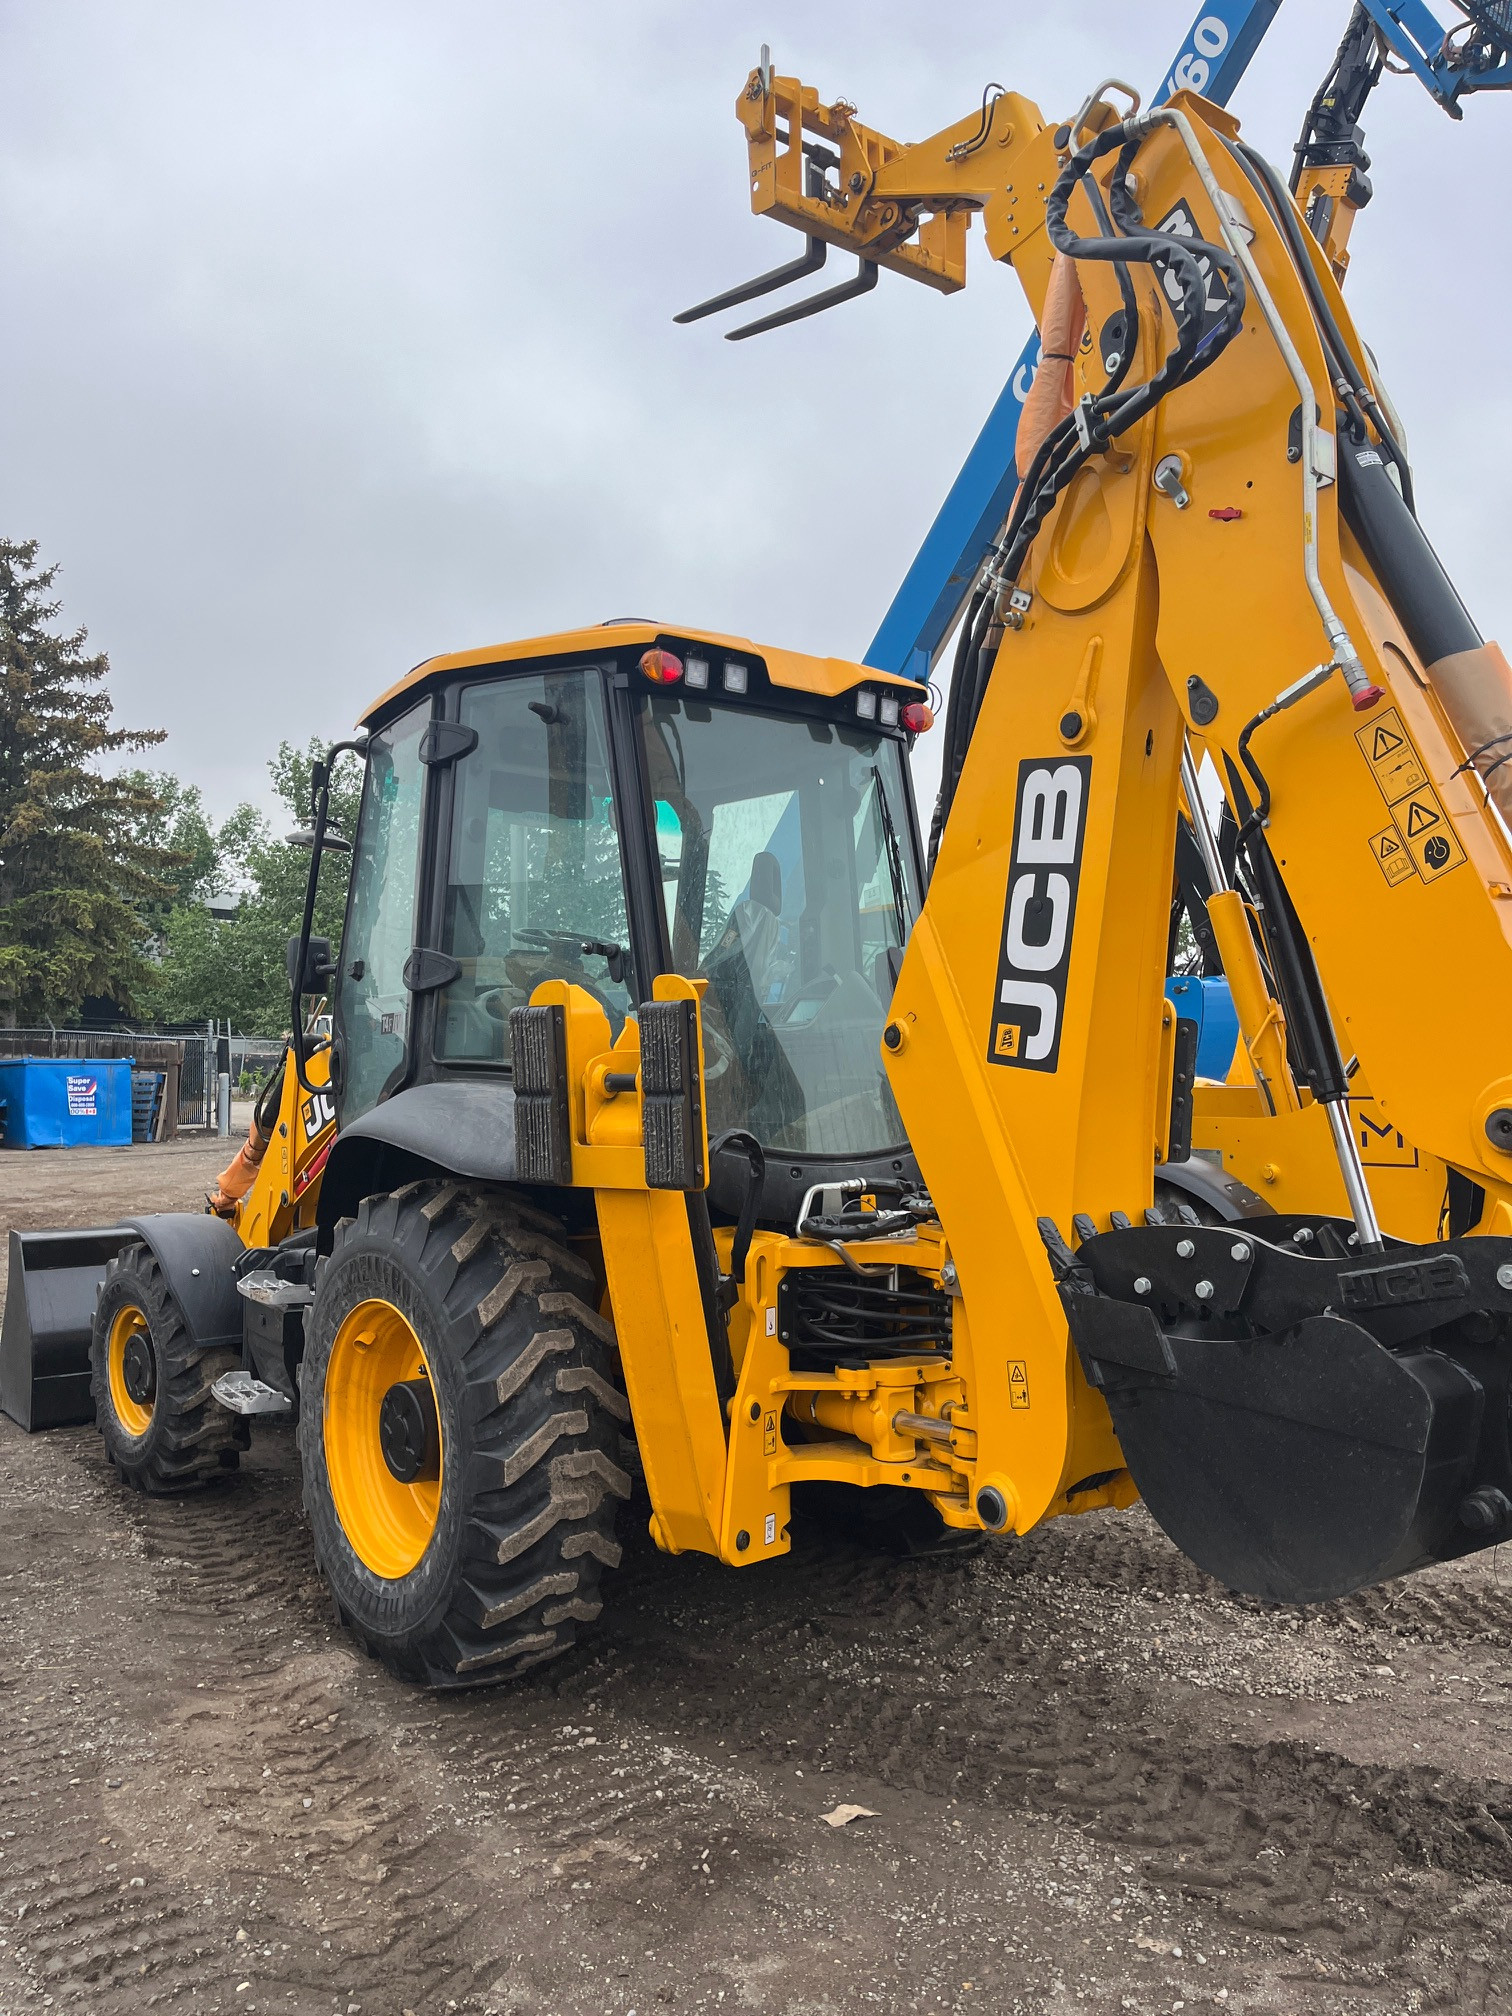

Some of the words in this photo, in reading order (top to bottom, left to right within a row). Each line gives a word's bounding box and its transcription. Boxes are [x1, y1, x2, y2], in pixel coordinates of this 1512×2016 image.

[1000, 764, 1083, 1061] JCB
[1001, 1028, 1014, 1048] JCB
[68, 1077, 90, 1085] Super
[306, 1081, 336, 1137] JC
